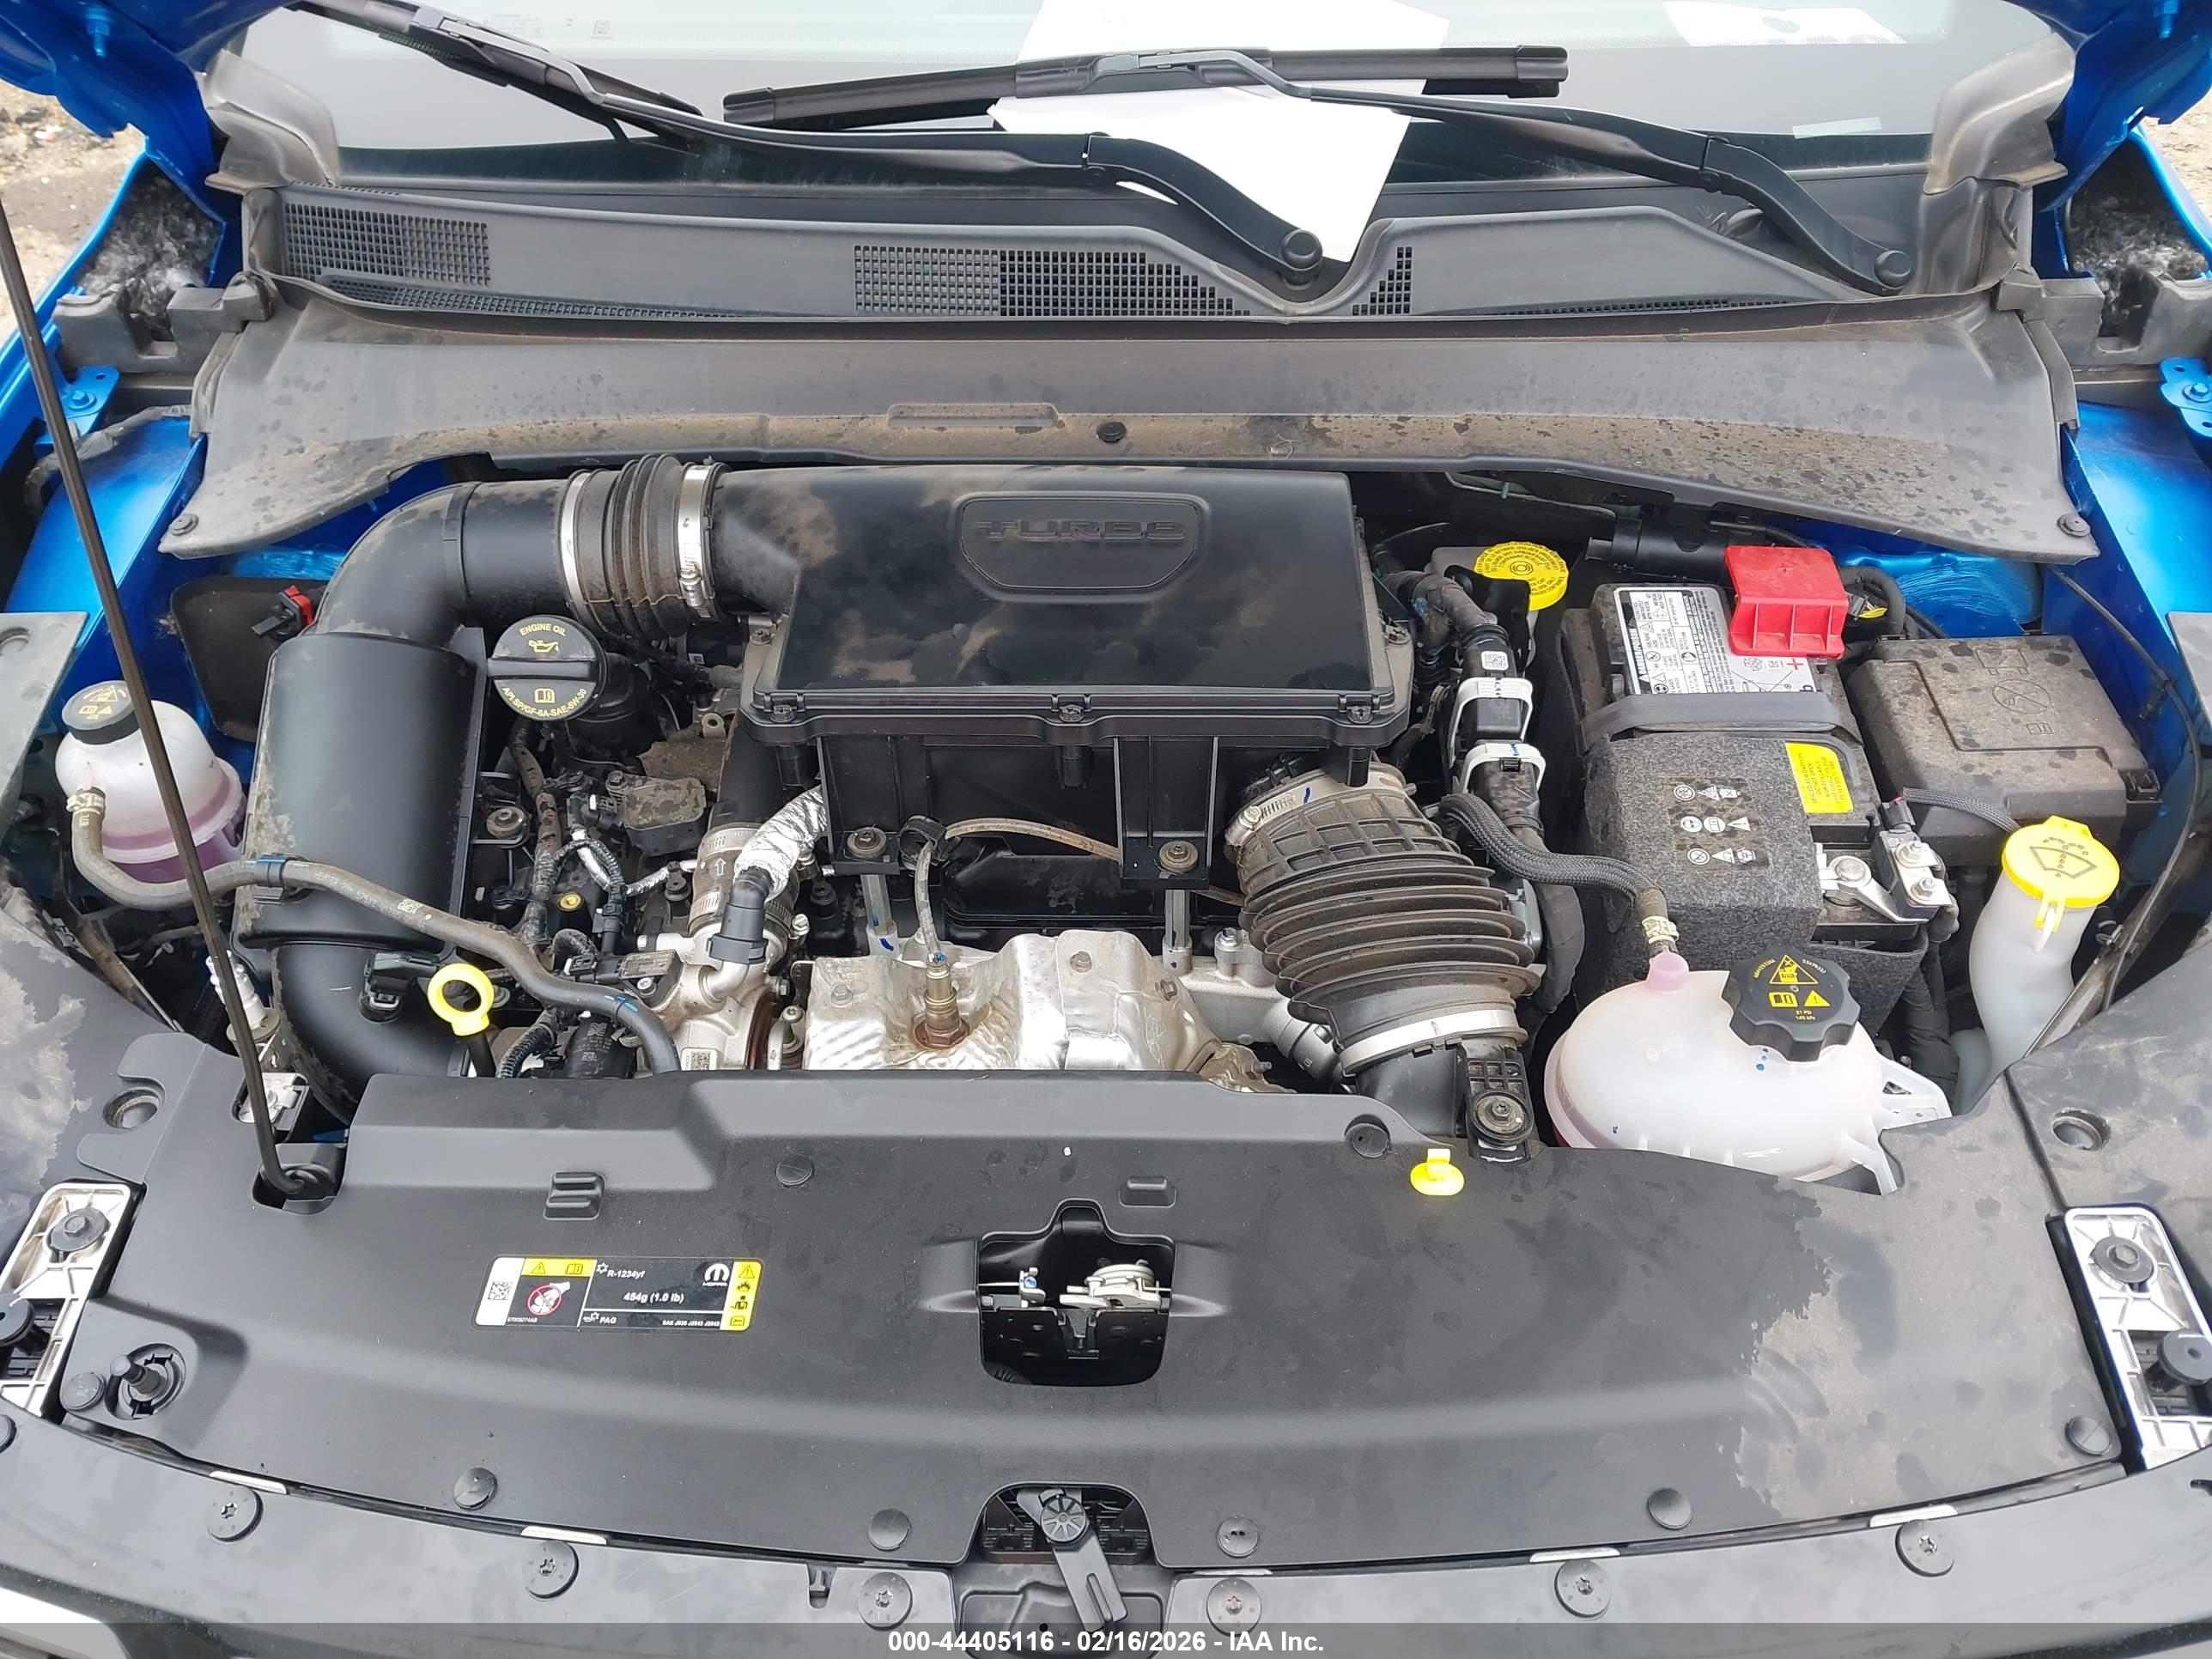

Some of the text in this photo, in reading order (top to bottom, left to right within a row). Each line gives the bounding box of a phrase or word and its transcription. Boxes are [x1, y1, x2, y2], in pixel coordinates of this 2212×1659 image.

[519, 623, 567, 636] ENGINE OIL
[501, 687, 515, 701] API
[606, 1270, 646, 1279] R-1234yf
[623, 1291, 684, 1304] 454g (1.0 lb)
